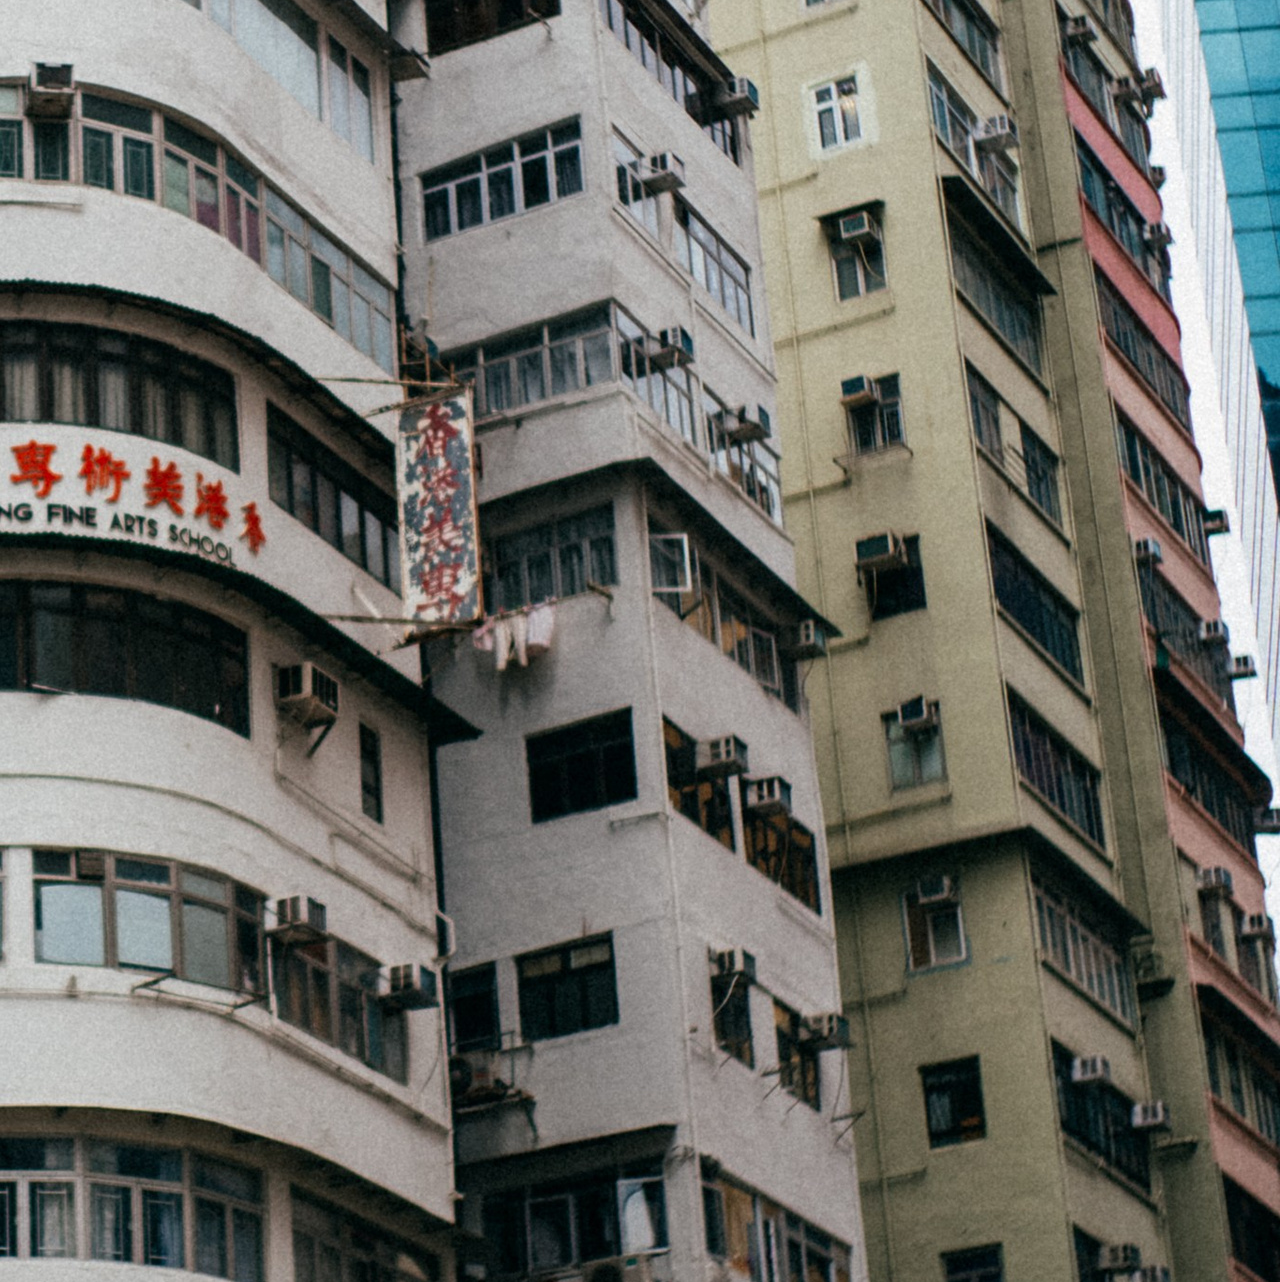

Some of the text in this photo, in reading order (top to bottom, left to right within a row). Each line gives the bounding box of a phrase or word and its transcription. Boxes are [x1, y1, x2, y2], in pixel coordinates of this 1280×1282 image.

[46, 504, 98, 528] FINE
[108, 512, 158, 539] ARTS
[169, 524, 238, 568] SCHOOL
